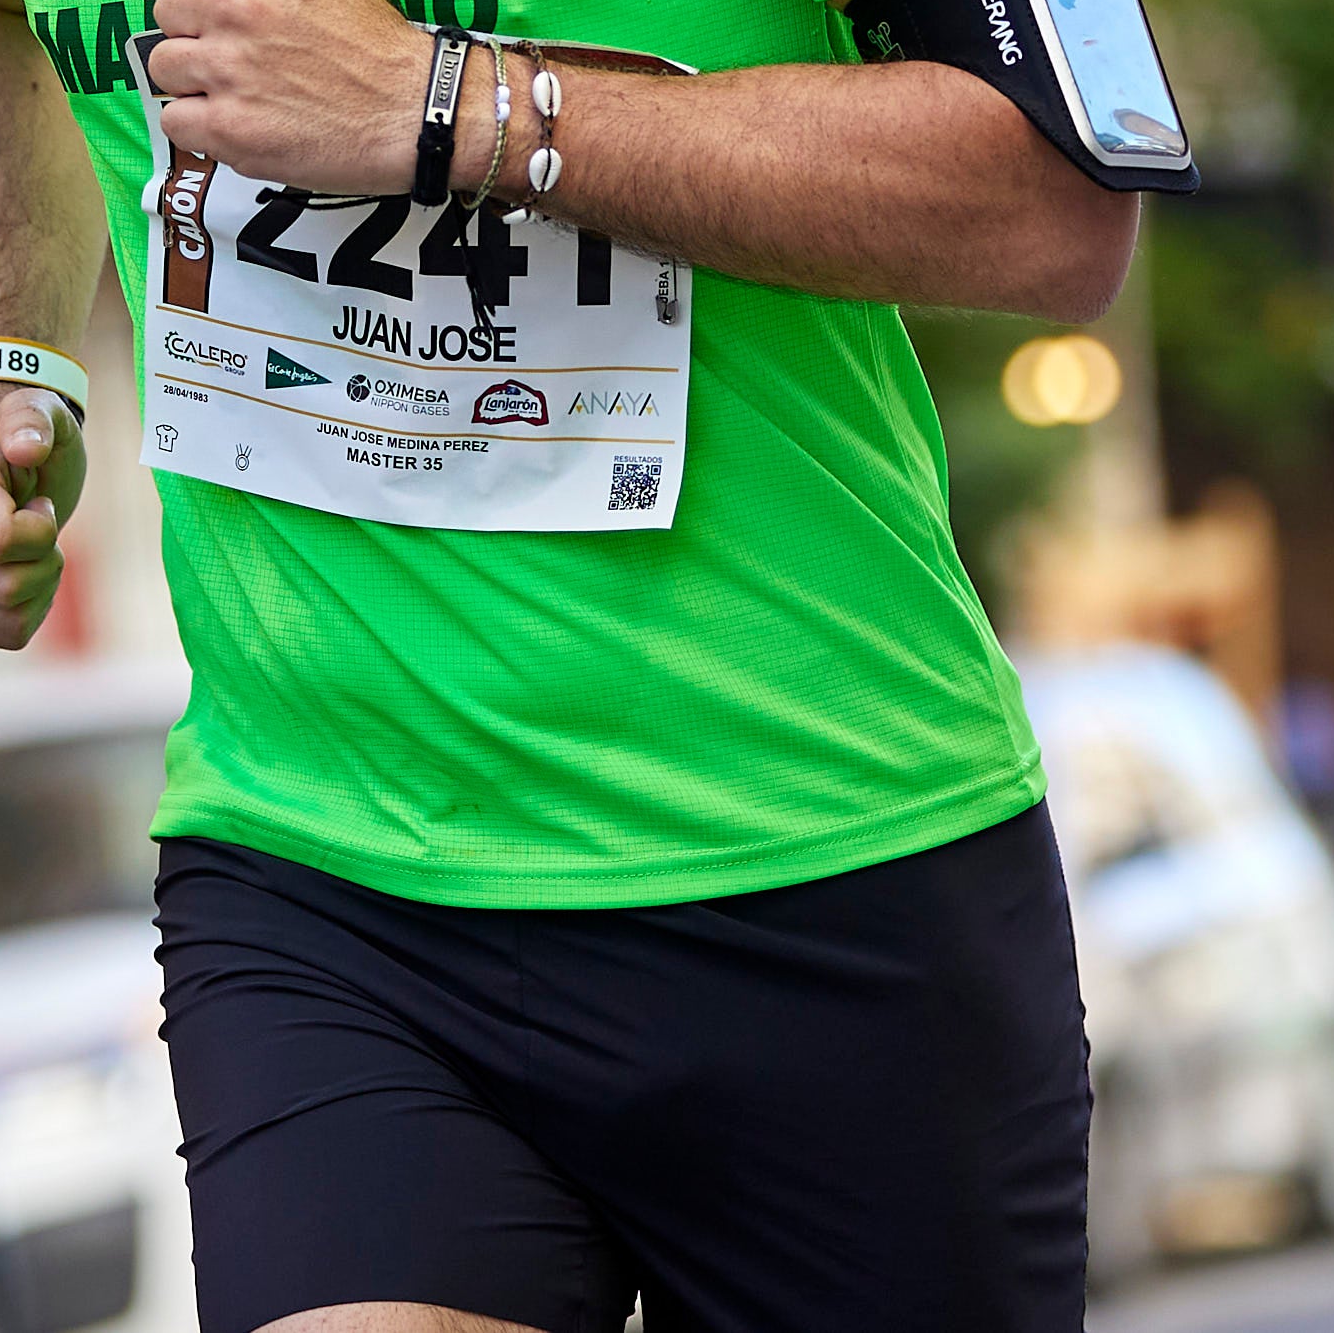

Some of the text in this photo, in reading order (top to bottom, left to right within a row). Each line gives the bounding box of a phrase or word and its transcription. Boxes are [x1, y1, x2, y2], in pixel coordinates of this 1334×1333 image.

[437, 59, 459, 102] hope
[166, 169, 206, 260] CAJÓN
[332, 305, 518, 363] JUAN JOSE
[171, 337, 246, 369] CALERO
[224, 366, 246, 377] GROUP
[163, 384, 209, 403] 28/04/1983
[374, 379, 450, 404] OXIMESA
[567, 391, 660, 417] ANAYA
[370, 396, 451, 417] NIPPON GASES
[483, 397, 538, 412] Lanjarón
[316, 422, 489, 453] JUAN JOSE MEDINA PEREZ
[346, 447, 443, 471] MASTER 35
[613, 455, 664, 464] RESULTADOS
